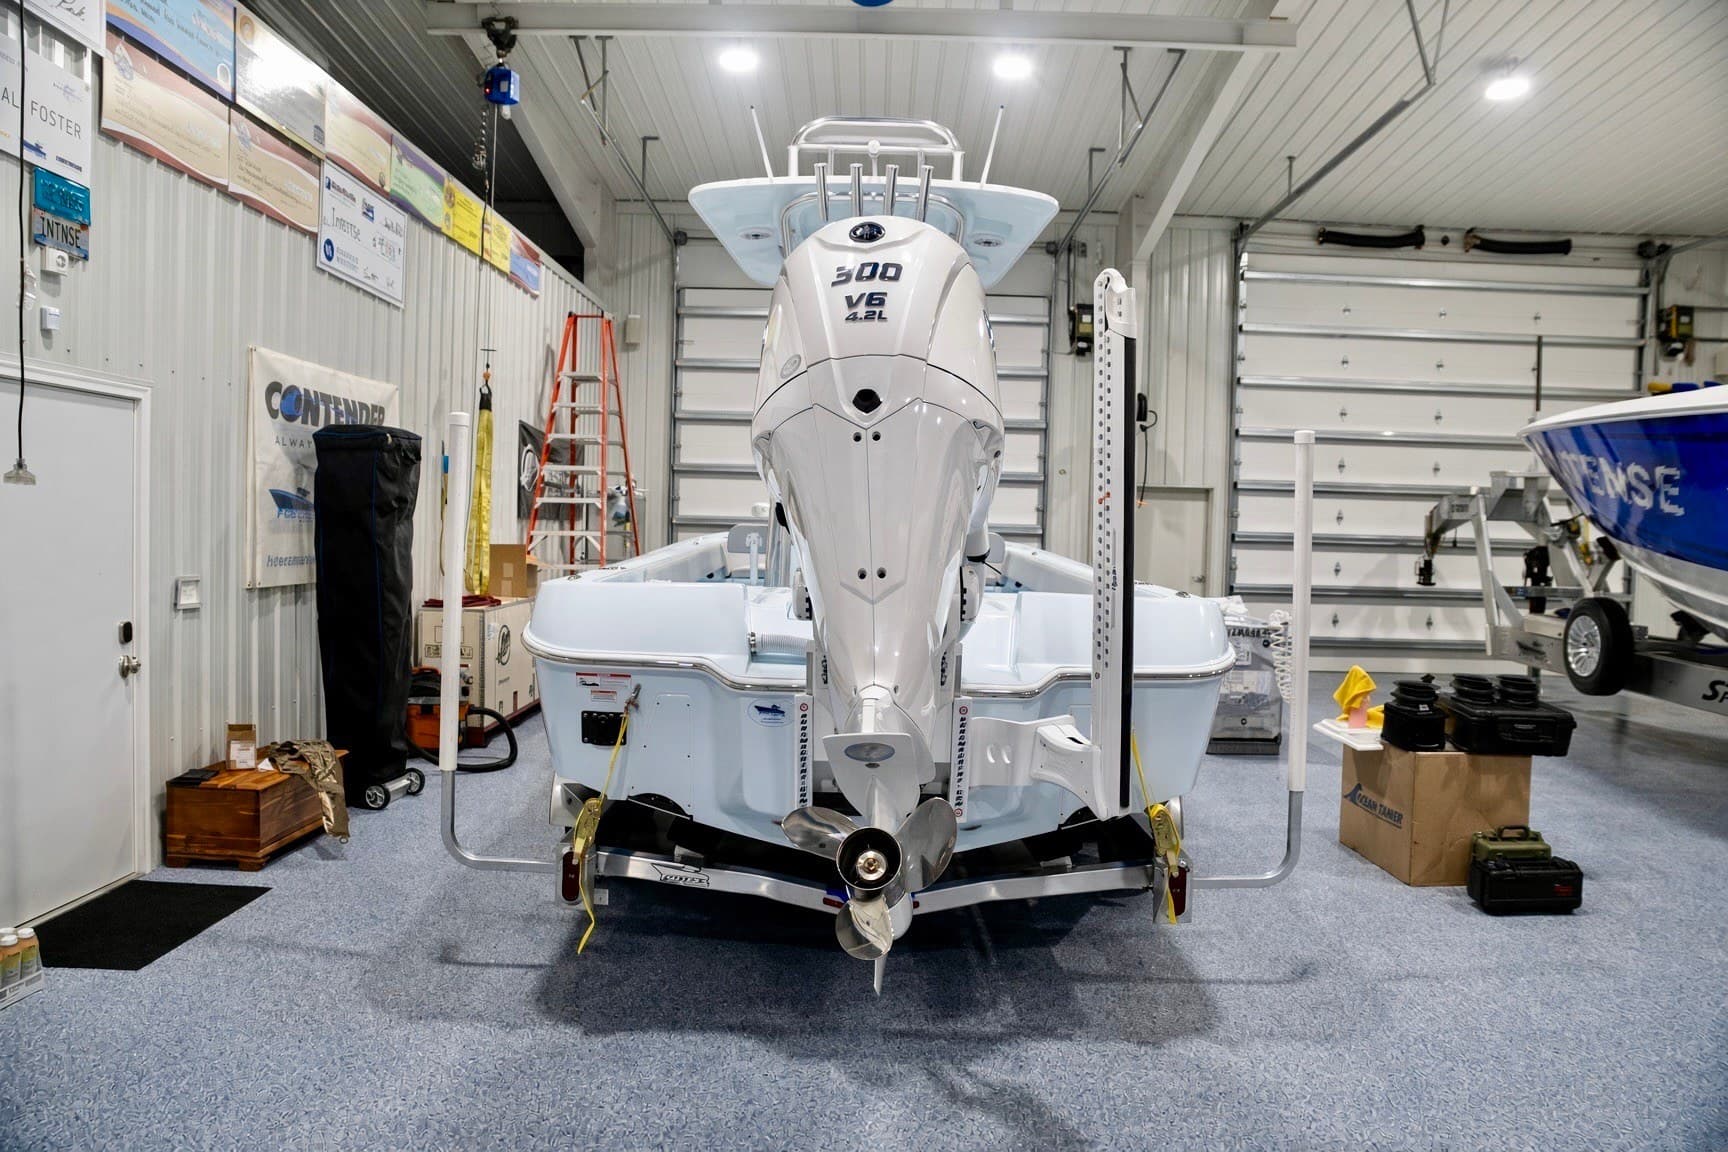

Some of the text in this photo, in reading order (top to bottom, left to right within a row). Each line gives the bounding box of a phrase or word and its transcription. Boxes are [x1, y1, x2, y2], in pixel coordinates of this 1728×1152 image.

[31, 100, 81, 140] FOSTER
[40, 217, 82, 249] INTNSE
[831, 262, 903, 288] 300
[845, 292, 888, 309] V6
[845, 310, 888, 321] 4.2L
[265, 381, 386, 427] CONTENDER
[275, 435, 313, 449] ALWAY
